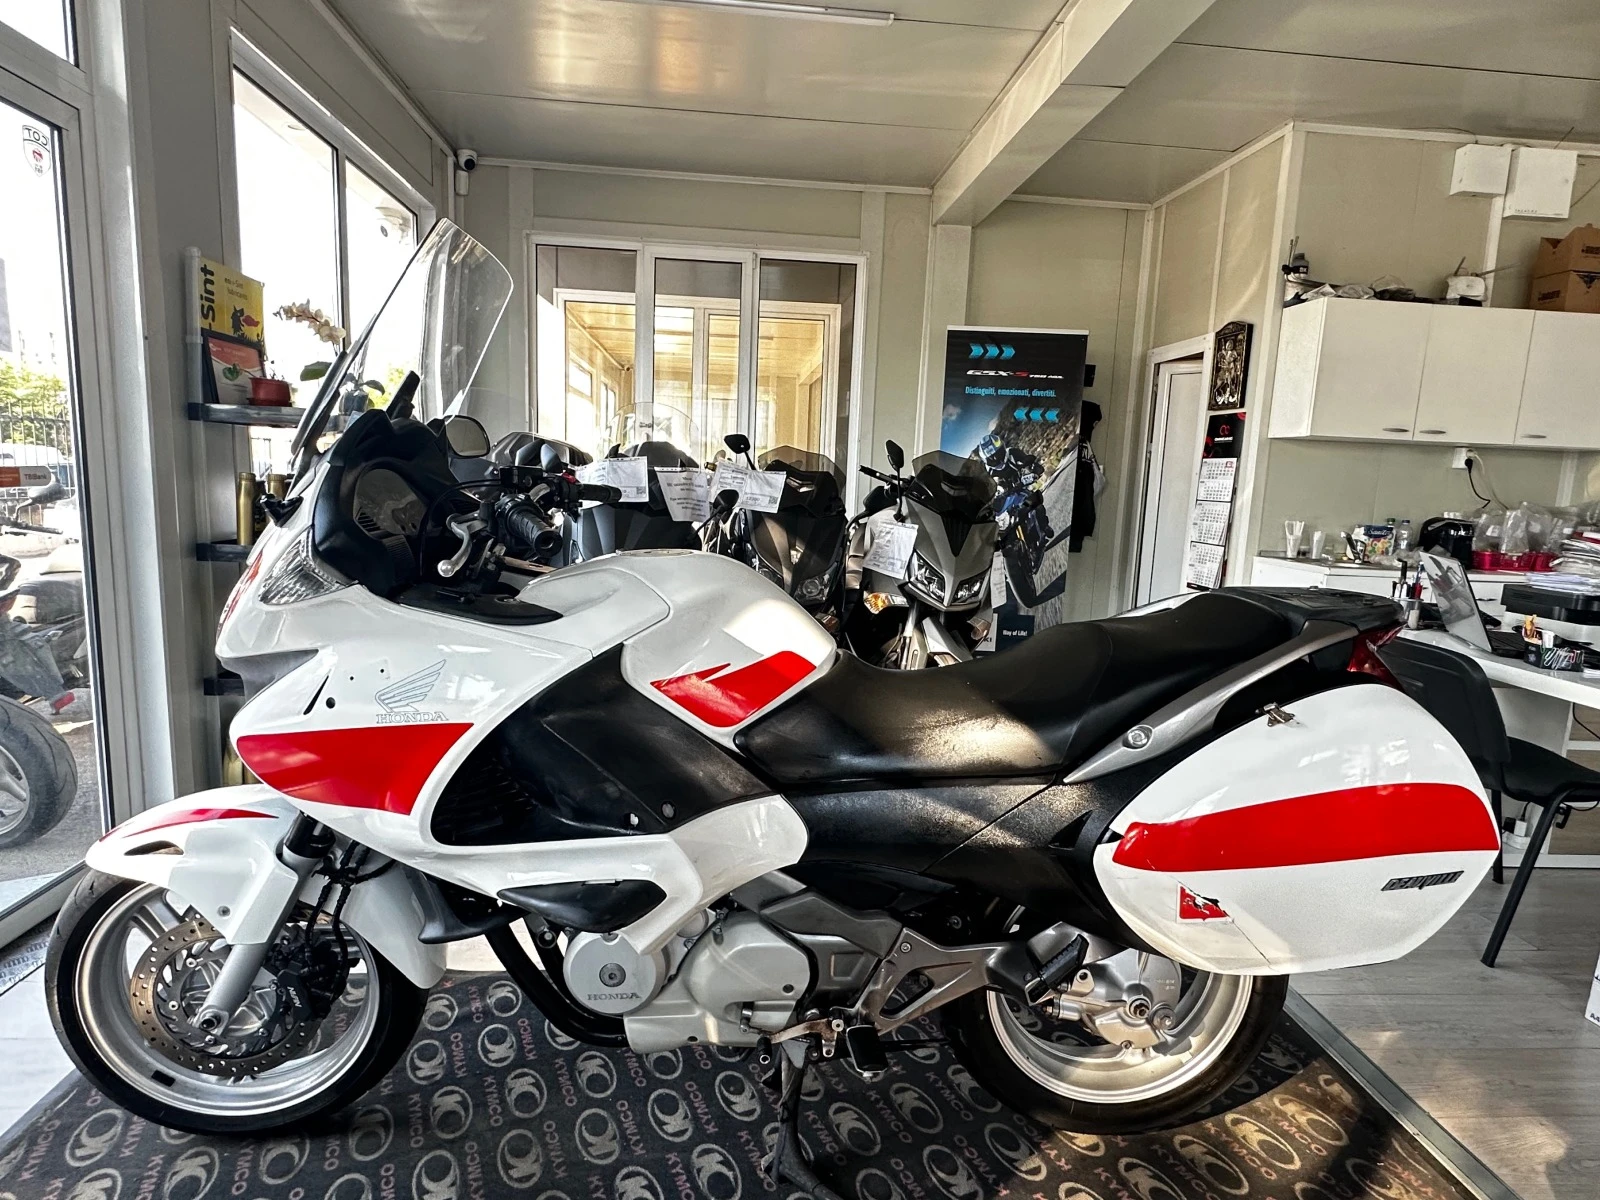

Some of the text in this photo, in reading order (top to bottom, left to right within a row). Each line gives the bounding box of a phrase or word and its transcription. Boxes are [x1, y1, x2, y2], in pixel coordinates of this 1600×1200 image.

[965, 386, 996, 397] Distinguiti,
[376, 711, 449, 724] HONDA
[587, 992, 641, 1001] HONDA
[483, 1075, 503, 1127] KYMCO
[555, 1057, 578, 1107] KYMCO
[684, 1081, 719, 1134] KYMCO
[408, 1093, 425, 1148] KYMCO
[616, 1100, 646, 1156] KYMCO
